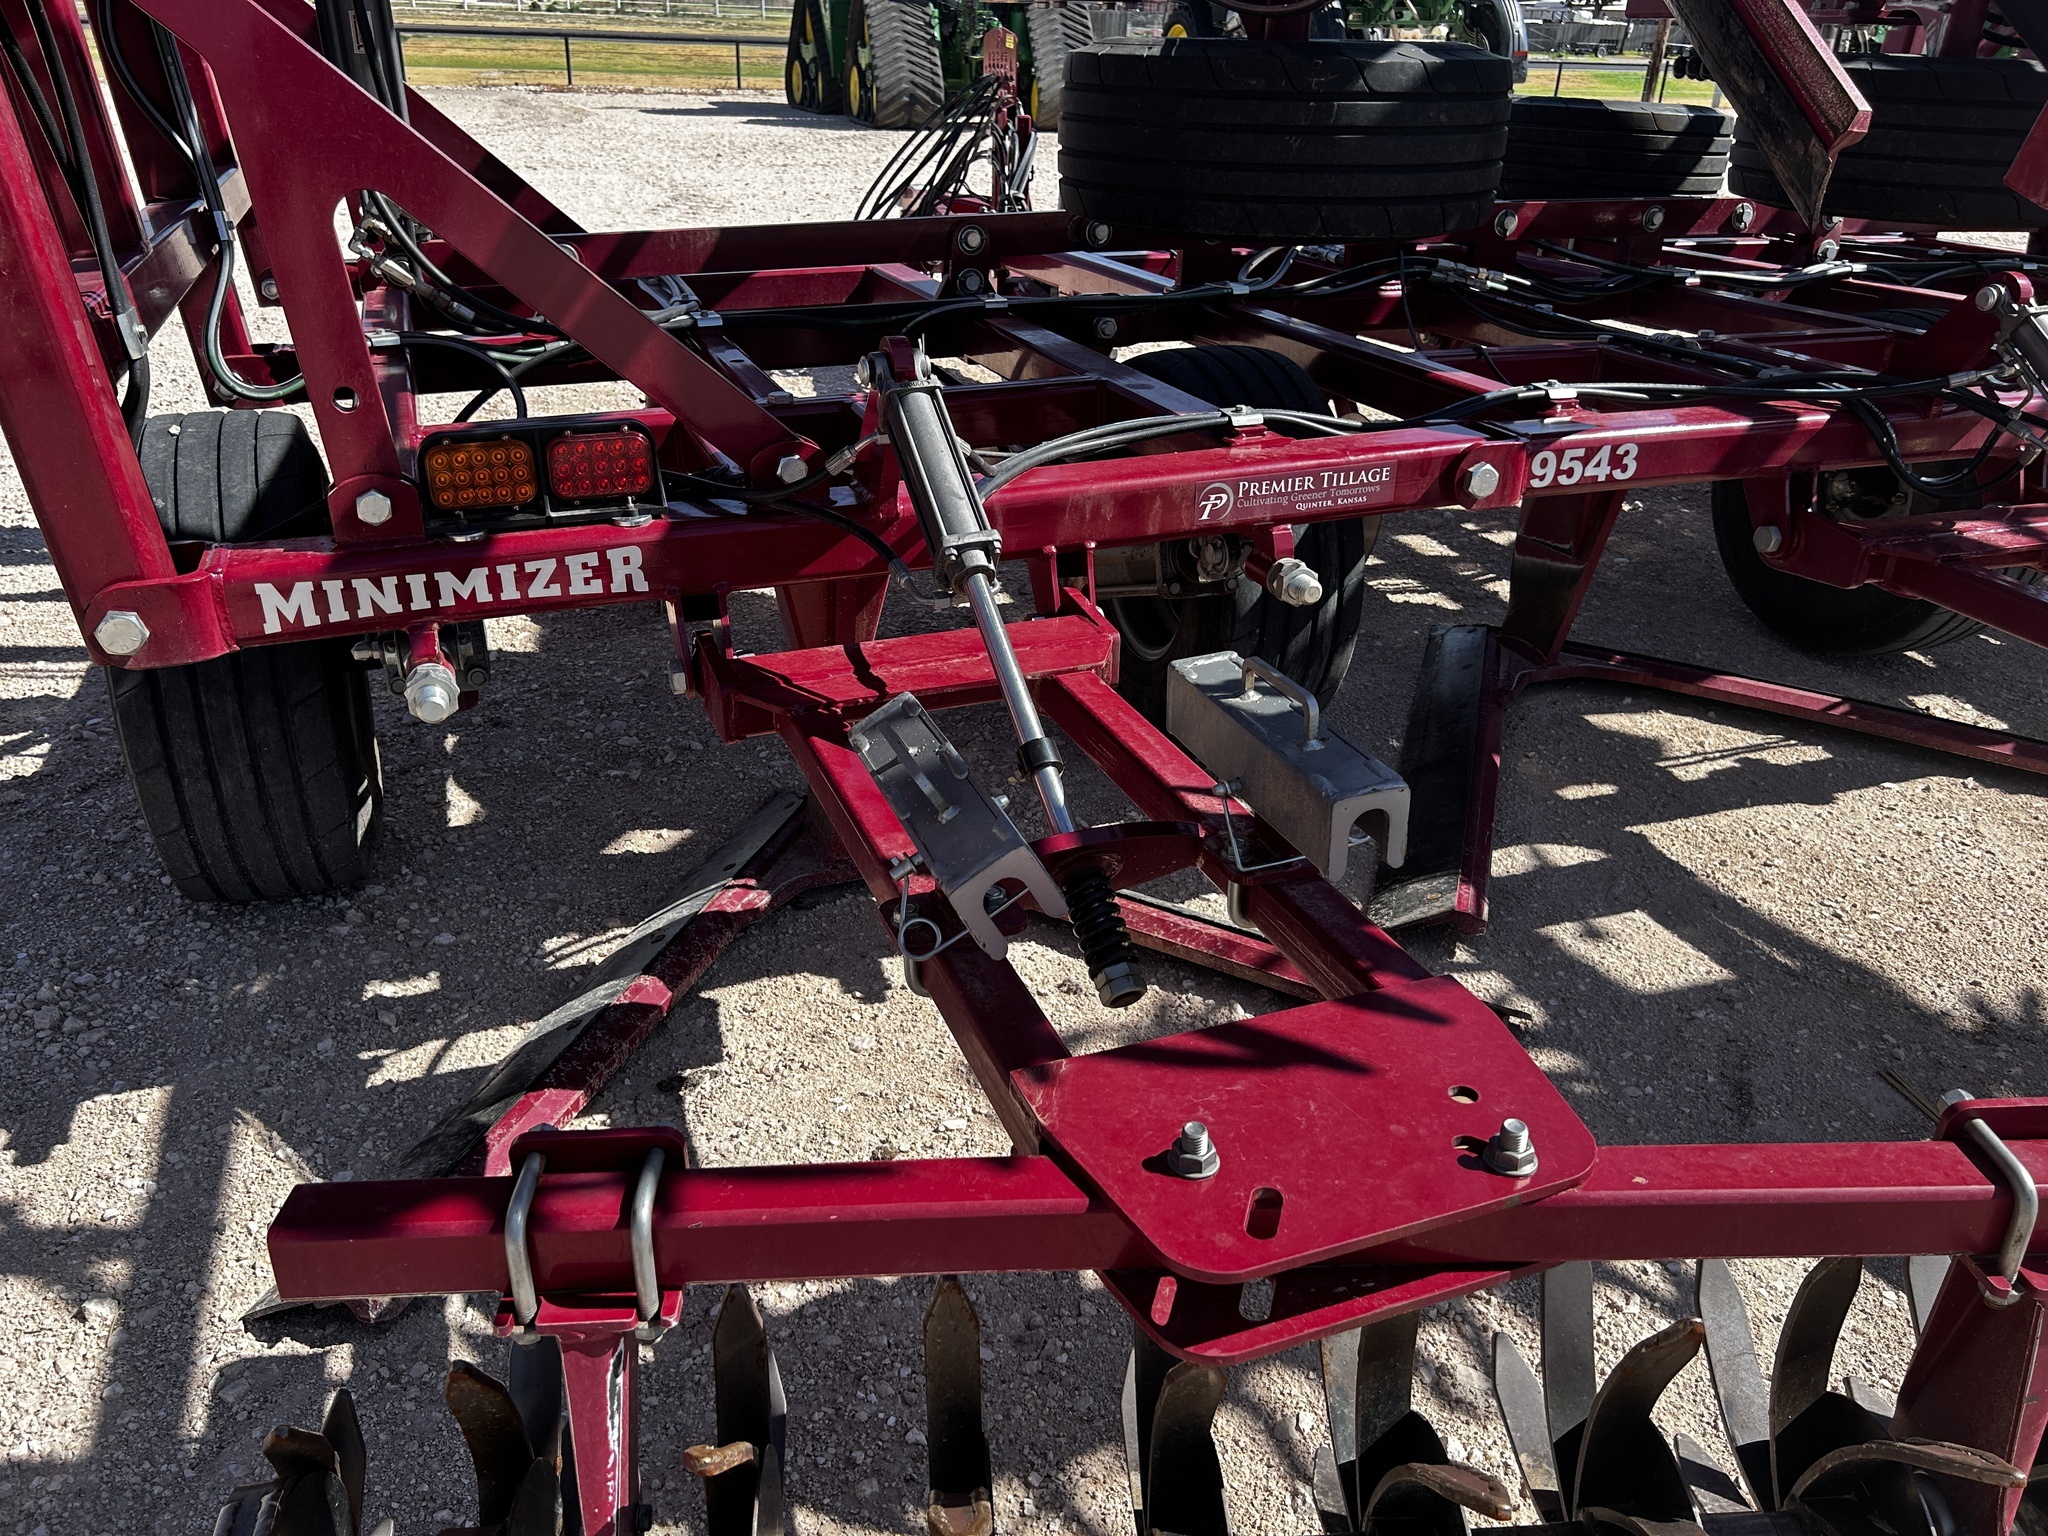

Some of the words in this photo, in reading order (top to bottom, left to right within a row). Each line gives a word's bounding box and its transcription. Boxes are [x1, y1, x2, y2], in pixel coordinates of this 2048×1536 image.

[1529, 442, 1639, 489] 9543
[1236, 494, 1289, 508] Cultivating
[1290, 490, 1328, 502] Greener
[1329, 484, 1381, 498] Tomorrows
[1237, 476, 1316, 498] PREMIER
[1319, 466, 1391, 488] TILLAGE
[1337, 495, 1367, 506] KANSAS
[254, 545, 649, 635] MINIMIZER
